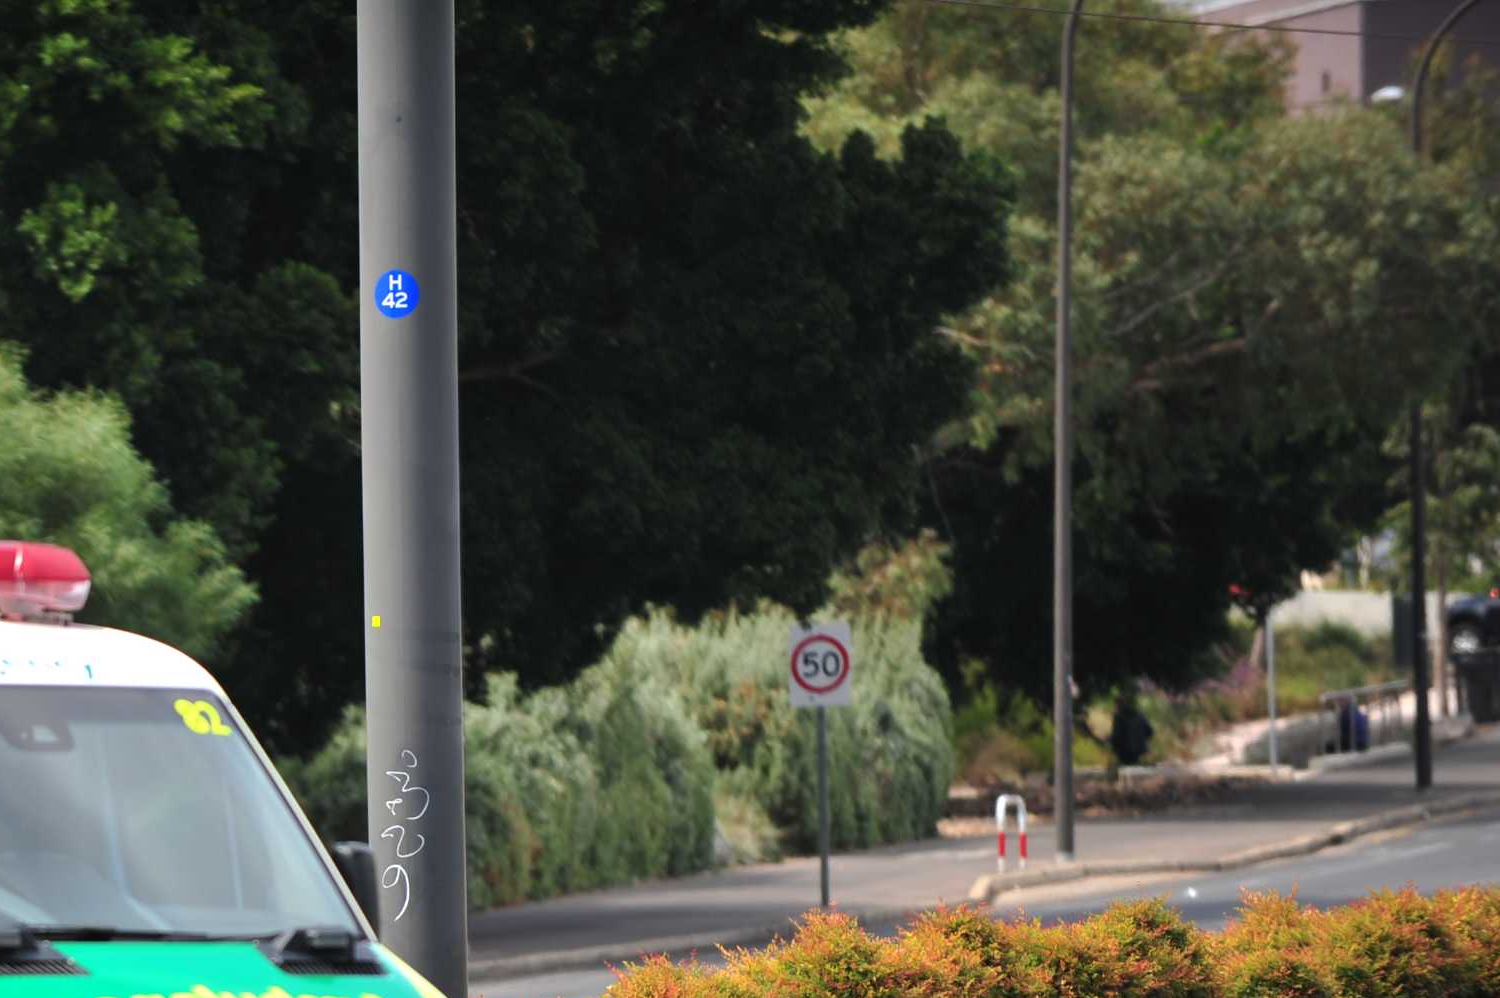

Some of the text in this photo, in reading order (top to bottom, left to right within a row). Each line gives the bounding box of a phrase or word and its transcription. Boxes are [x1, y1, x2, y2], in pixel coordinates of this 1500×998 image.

[388, 273, 403, 291] H
[381, 291, 409, 309] 42
[803, 650, 840, 678] 50
[172, 698, 232, 736] 82
